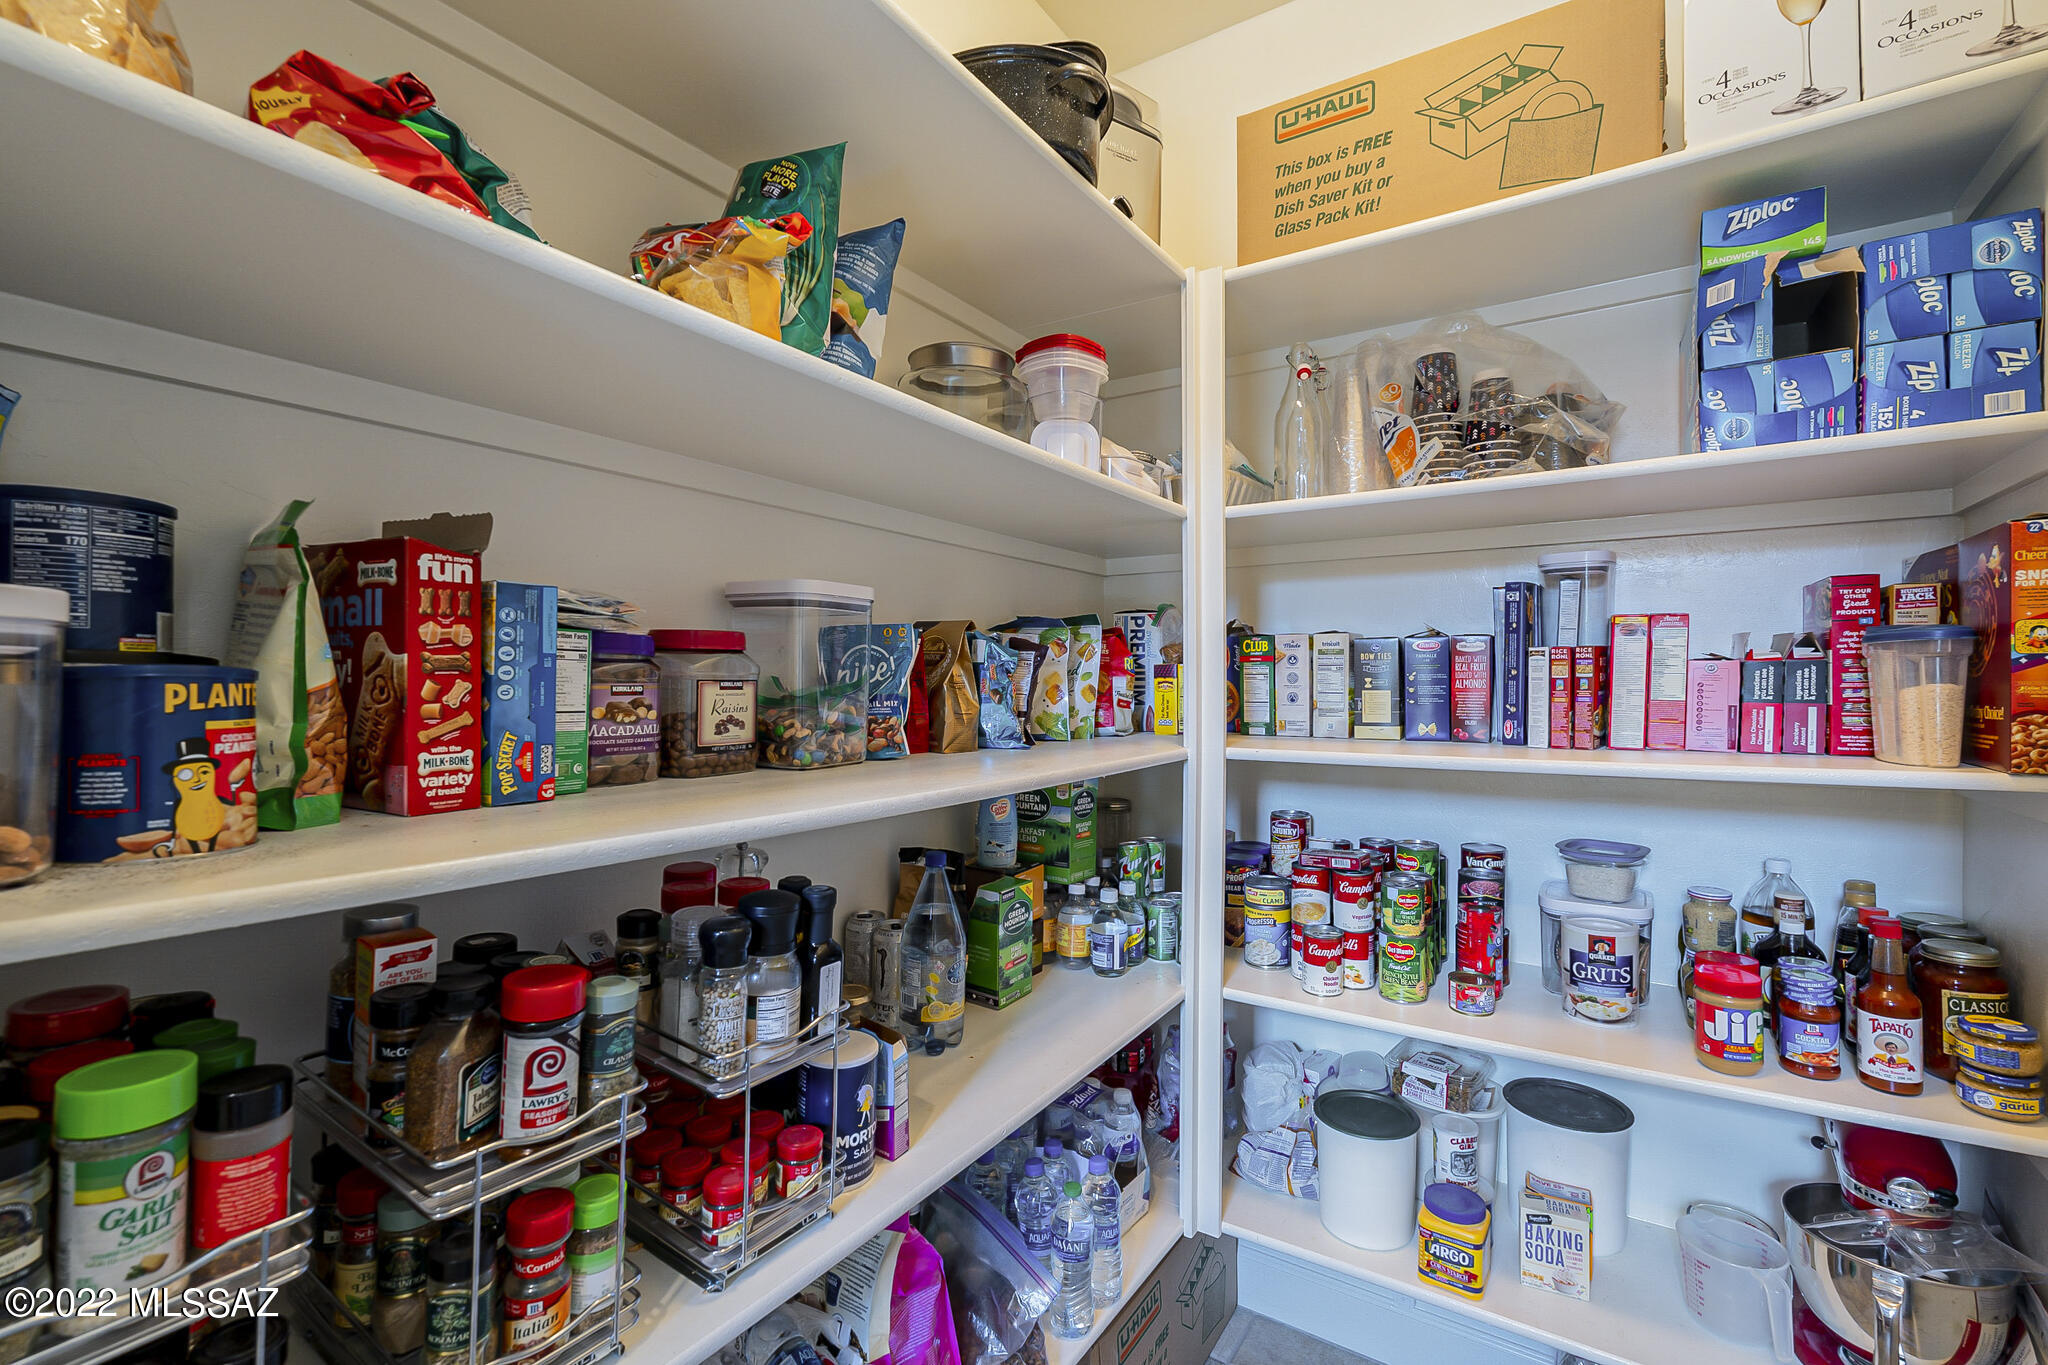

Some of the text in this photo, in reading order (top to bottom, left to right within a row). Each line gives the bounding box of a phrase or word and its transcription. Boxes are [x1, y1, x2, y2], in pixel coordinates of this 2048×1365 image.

[1898, 9, 1917, 30] 4
[1877, 9, 1983, 48] OCCASIONS
[1716, 69, 1732, 89] 4
[1698, 72, 1786, 105] OCCASIONS
[1281, 87, 1369, 129] U-HAUL
[1275, 130, 1393, 179] This box is FREE
[781, 159, 798, 169] NOW
[771, 164, 800, 181] MORE
[1275, 156, 1385, 199] when you buy a
[763, 172, 798, 192] FLAVOR
[1274, 174, 1394, 219] Dish Saver Kit or
[1274, 196, 1381, 238] Glass Pack Kit!
[1726, 197, 1795, 234] Ziploc
[1803, 235, 1822, 246] 145
[2012, 218, 2036, 253] Ziploc
[1756, 324, 1764, 358] FREEZER
[1962, 333, 1972, 370] FREEZER
[1876, 347, 1885, 382] FREEZER
[1902, 396, 1910, 415] BOXES
[1877, 405, 1894, 429] 152
[1910, 409, 1926, 419] 4
[59, 503, 88, 514] Facts
[64, 535, 88, 546] 170
[434, 553, 473, 564] life's more
[417, 553, 474, 585] fun
[1842, 598, 1870, 608] Great
[1899, 592, 1936, 602] JACK
[1836, 608, 1876, 616] PRODUCTS
[1243, 640, 1269, 653] CLUB
[1360, 653, 1376, 661] BOW
[1455, 655, 1487, 663] BAKED WITH
[836, 655, 896, 683] nice!
[1455, 662, 1487, 671] REAL FRUIT
[1455, 671, 1487, 679] LOADED WITH
[1455, 679, 1487, 689] ALMONDS
[710, 698, 749, 717] Raisins
[883, 699, 899, 707] MIX
[1792, 721, 1801, 746] Cranberry
[430, 744, 462, 754] with the
[418, 771, 474, 788] variety
[425, 785, 466, 798] of treats!
[542, 787, 554, 798] 6
[1073, 803, 1094, 812] MOUNTAIN
[1077, 797, 1091, 806] GREEN
[1271, 826, 1297, 836] CHUNKY
[1404, 858, 1418, 867] Monte
[1262, 897, 1284, 905] CLAMS
[1003, 912, 1029, 928] MOUNTAIN
[1008, 907, 1026, 919] GREEN
[1246, 917, 1275, 926] PROGRESSO
[1387, 945, 1415, 956] Del Monte
[1588, 953, 1616, 962] QUAKER
[387, 967, 423, 979] ARE YOU
[1383, 969, 1420, 980] FRENCH STYLE
[1572, 961, 1632, 985] GRITS
[378, 975, 411, 987] ONE OF
[1383, 976, 1418, 986] GREEN BEANS
[717, 1020, 741, 1032] WHITE
[1703, 1008, 1764, 1045] Jif
[1868, 1018, 1914, 1039] TAPATÍO
[1794, 1033, 1831, 1045] COCKTAIL
[521, 1090, 570, 1110] LAWRY'S
[1999, 1101, 2036, 1113] garlic
[535, 1114, 558, 1127] SALT
[853, 1140, 875, 1159] SALT
[1545, 1199, 1581, 1213] BAKING
[1545, 1206, 1571, 1216] SODA
[118, 1205, 176, 1248] SALT
[1525, 1221, 1584, 1252] BAKING
[1429, 1242, 1470, 1266] ARGO
[1525, 1241, 1565, 1268] SODA
[513, 1252, 566, 1276] McCormick
[1429, 1260, 1469, 1283] CORN STARCH
[512, 1312, 560, 1341] Italian
[1120, 1290, 1160, 1350] U-HAUL
[1154, 1321, 1170, 1354] FREE
